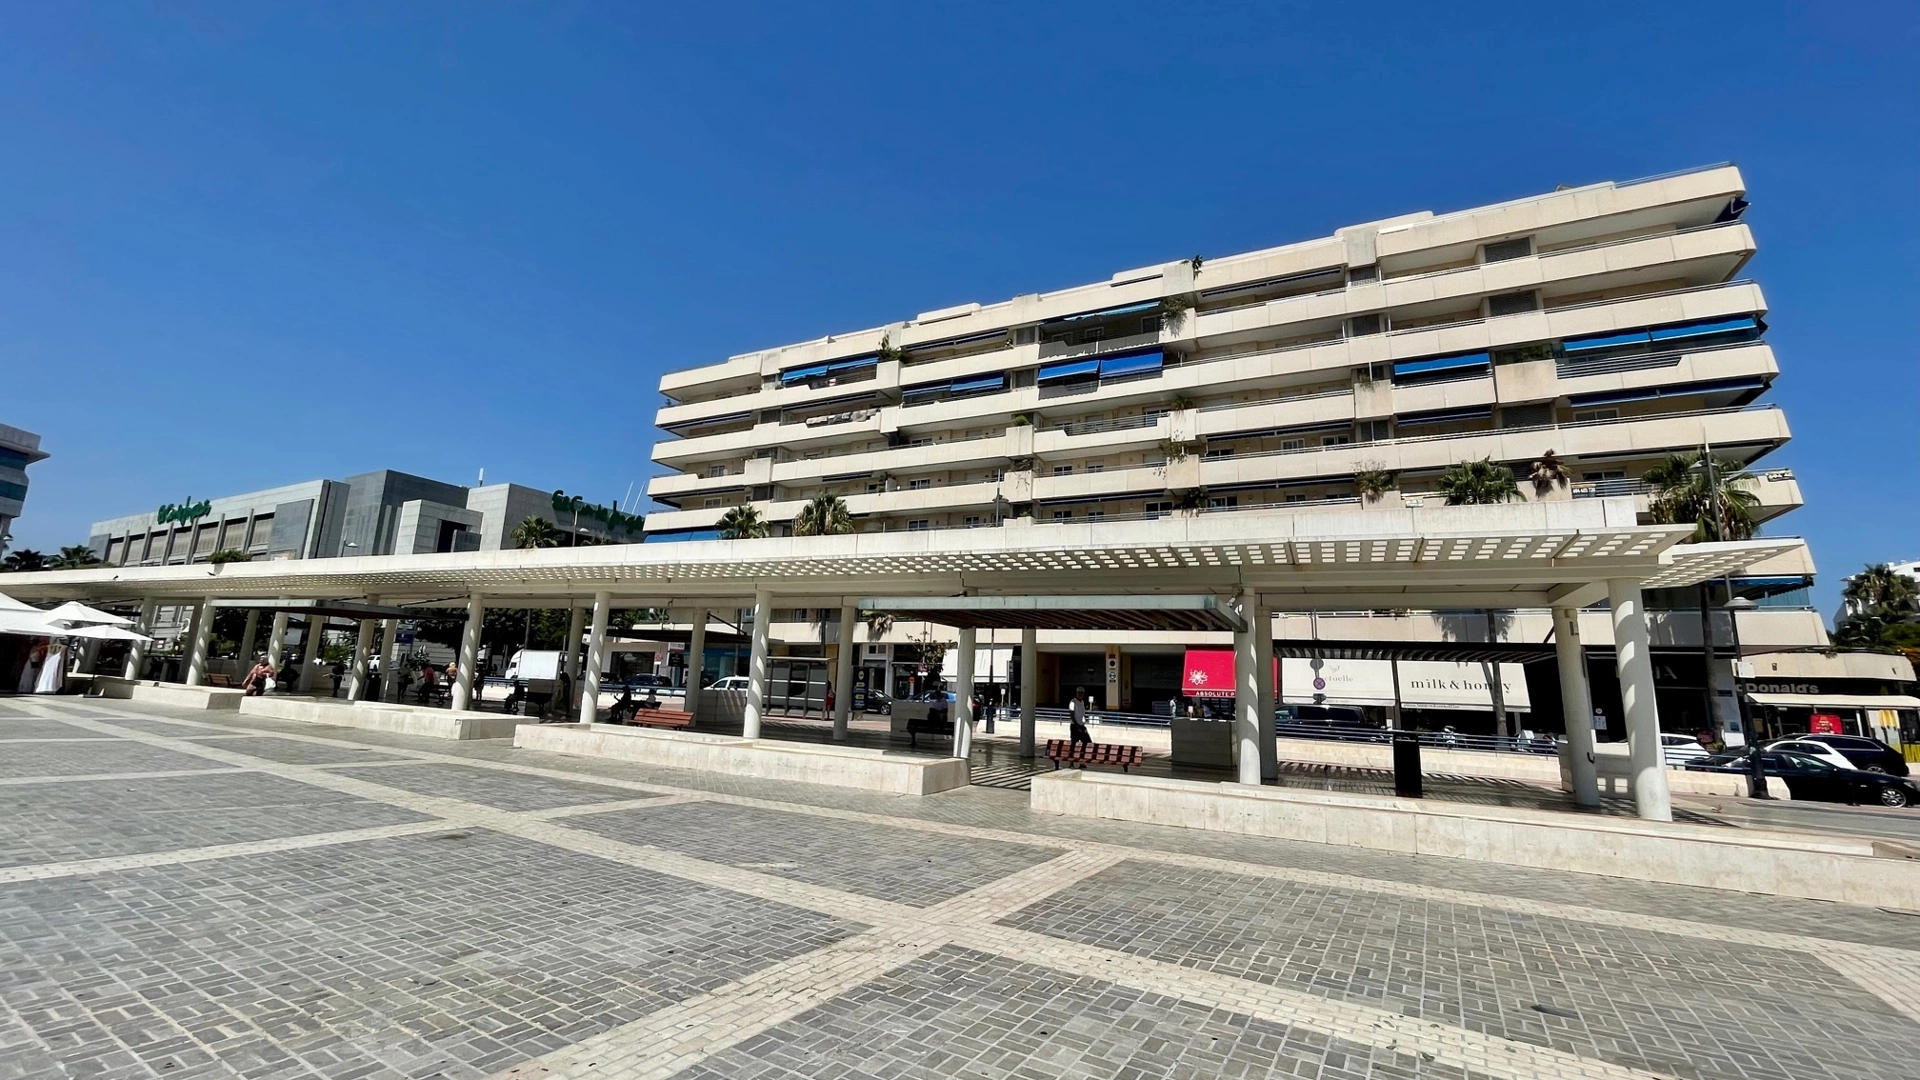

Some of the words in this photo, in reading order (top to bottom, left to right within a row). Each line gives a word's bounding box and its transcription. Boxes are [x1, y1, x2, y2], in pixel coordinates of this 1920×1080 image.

[1411, 678, 1447, 690] milk
[1449, 680, 1460, 690] &
[1463, 680, 1512, 694] hony
[1736, 682, 1820, 694] cDonald's
